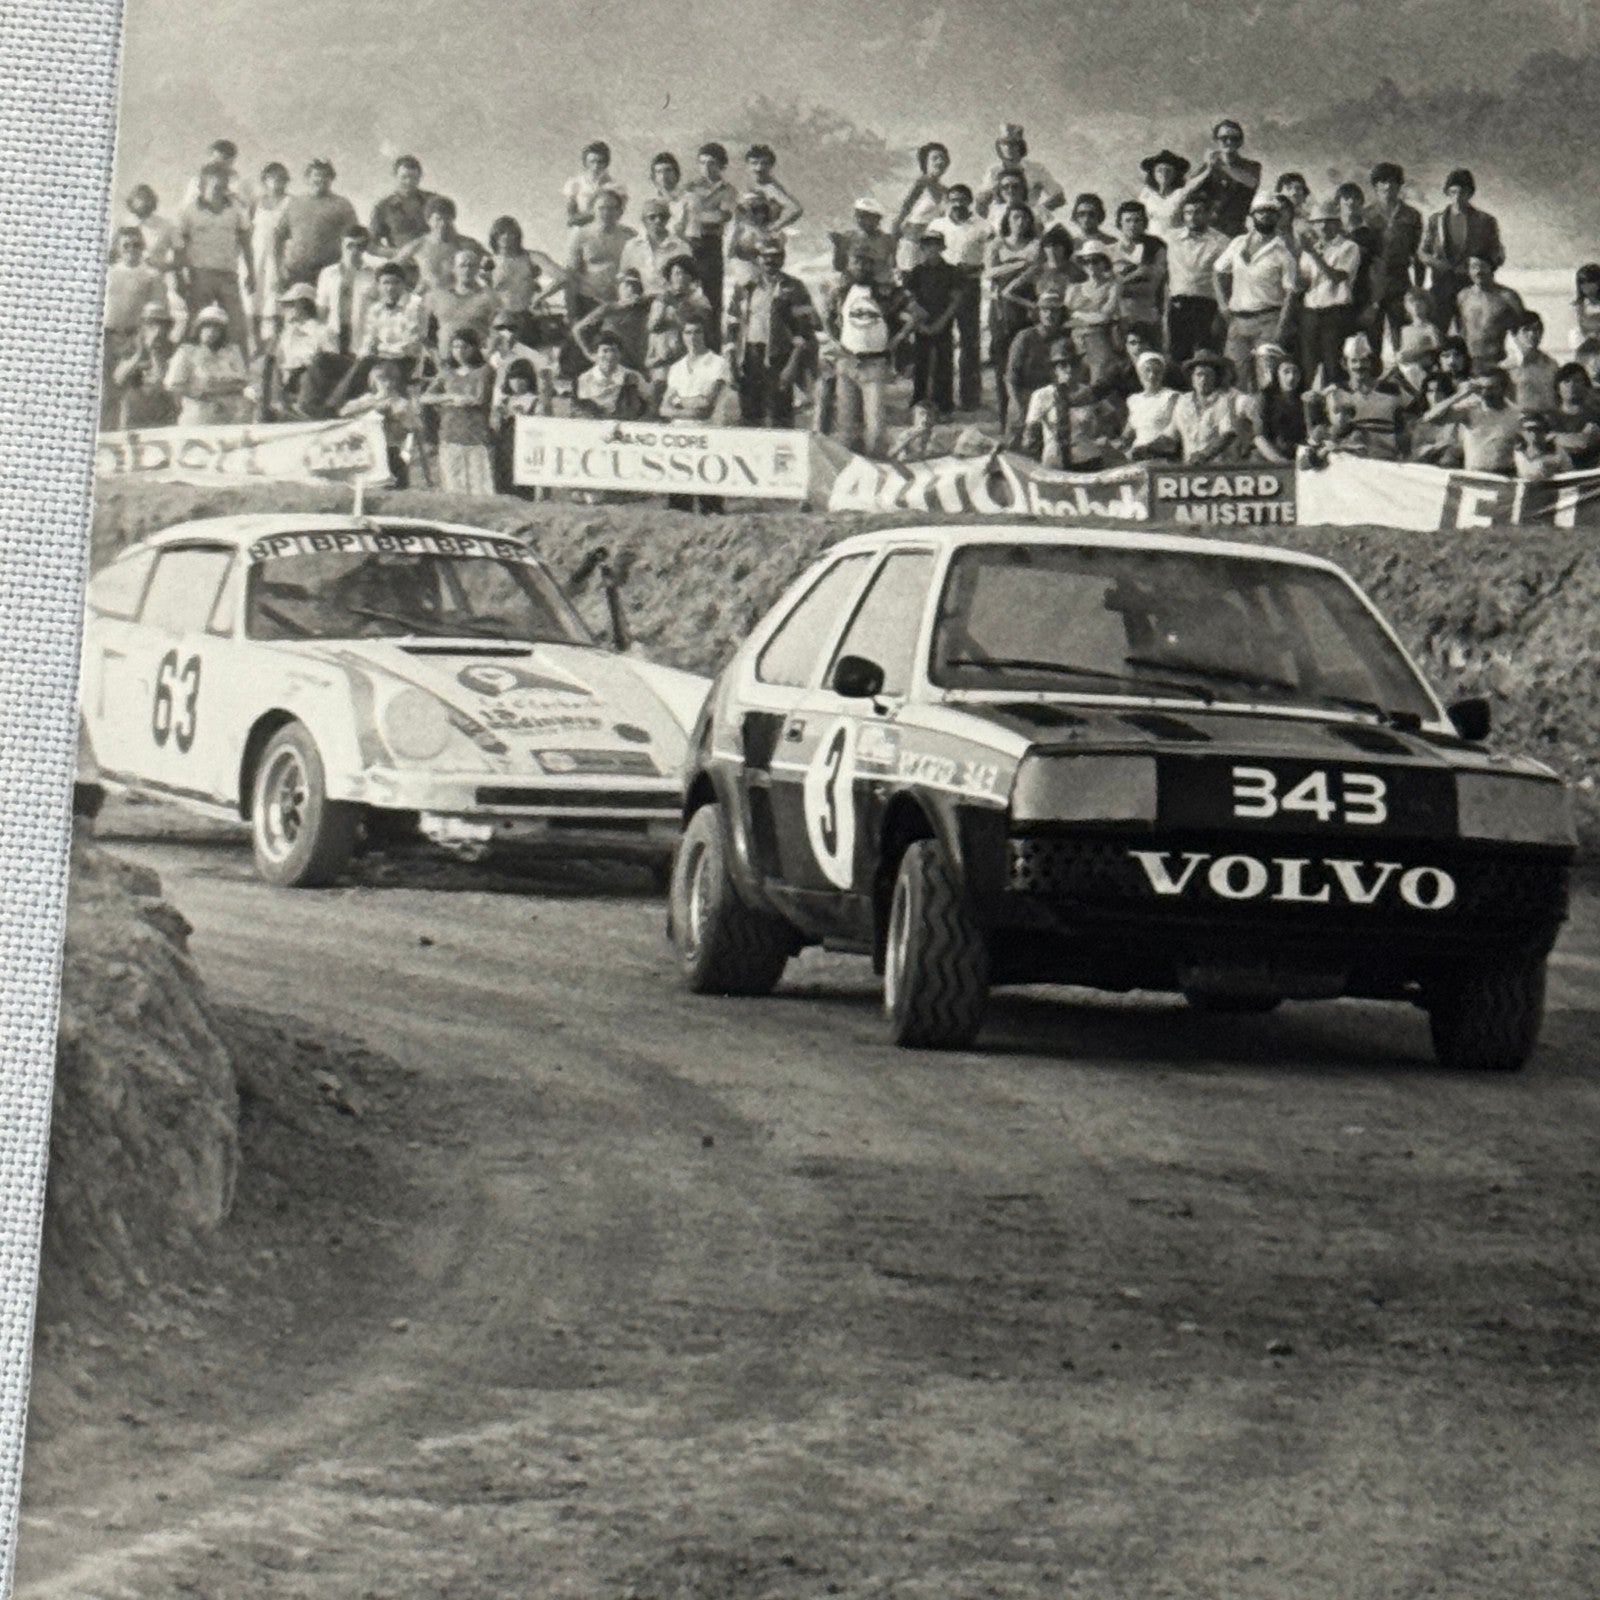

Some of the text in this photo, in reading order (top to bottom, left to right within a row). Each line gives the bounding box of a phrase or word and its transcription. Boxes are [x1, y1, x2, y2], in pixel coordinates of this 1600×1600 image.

[553, 446, 759, 486] ECUSSON
[1157, 475, 1279, 498] RICARD
[1175, 501, 1296, 525] ANISETTE
[311, 534, 355, 552] BP
[375, 535, 418, 552] BP
[437, 538, 476, 554] BP
[152, 649, 201, 754] 63
[819, 726, 847, 858] 3
[1232, 766, 1388, 824] 343
[1127, 851, 1456, 910] VOLVO
